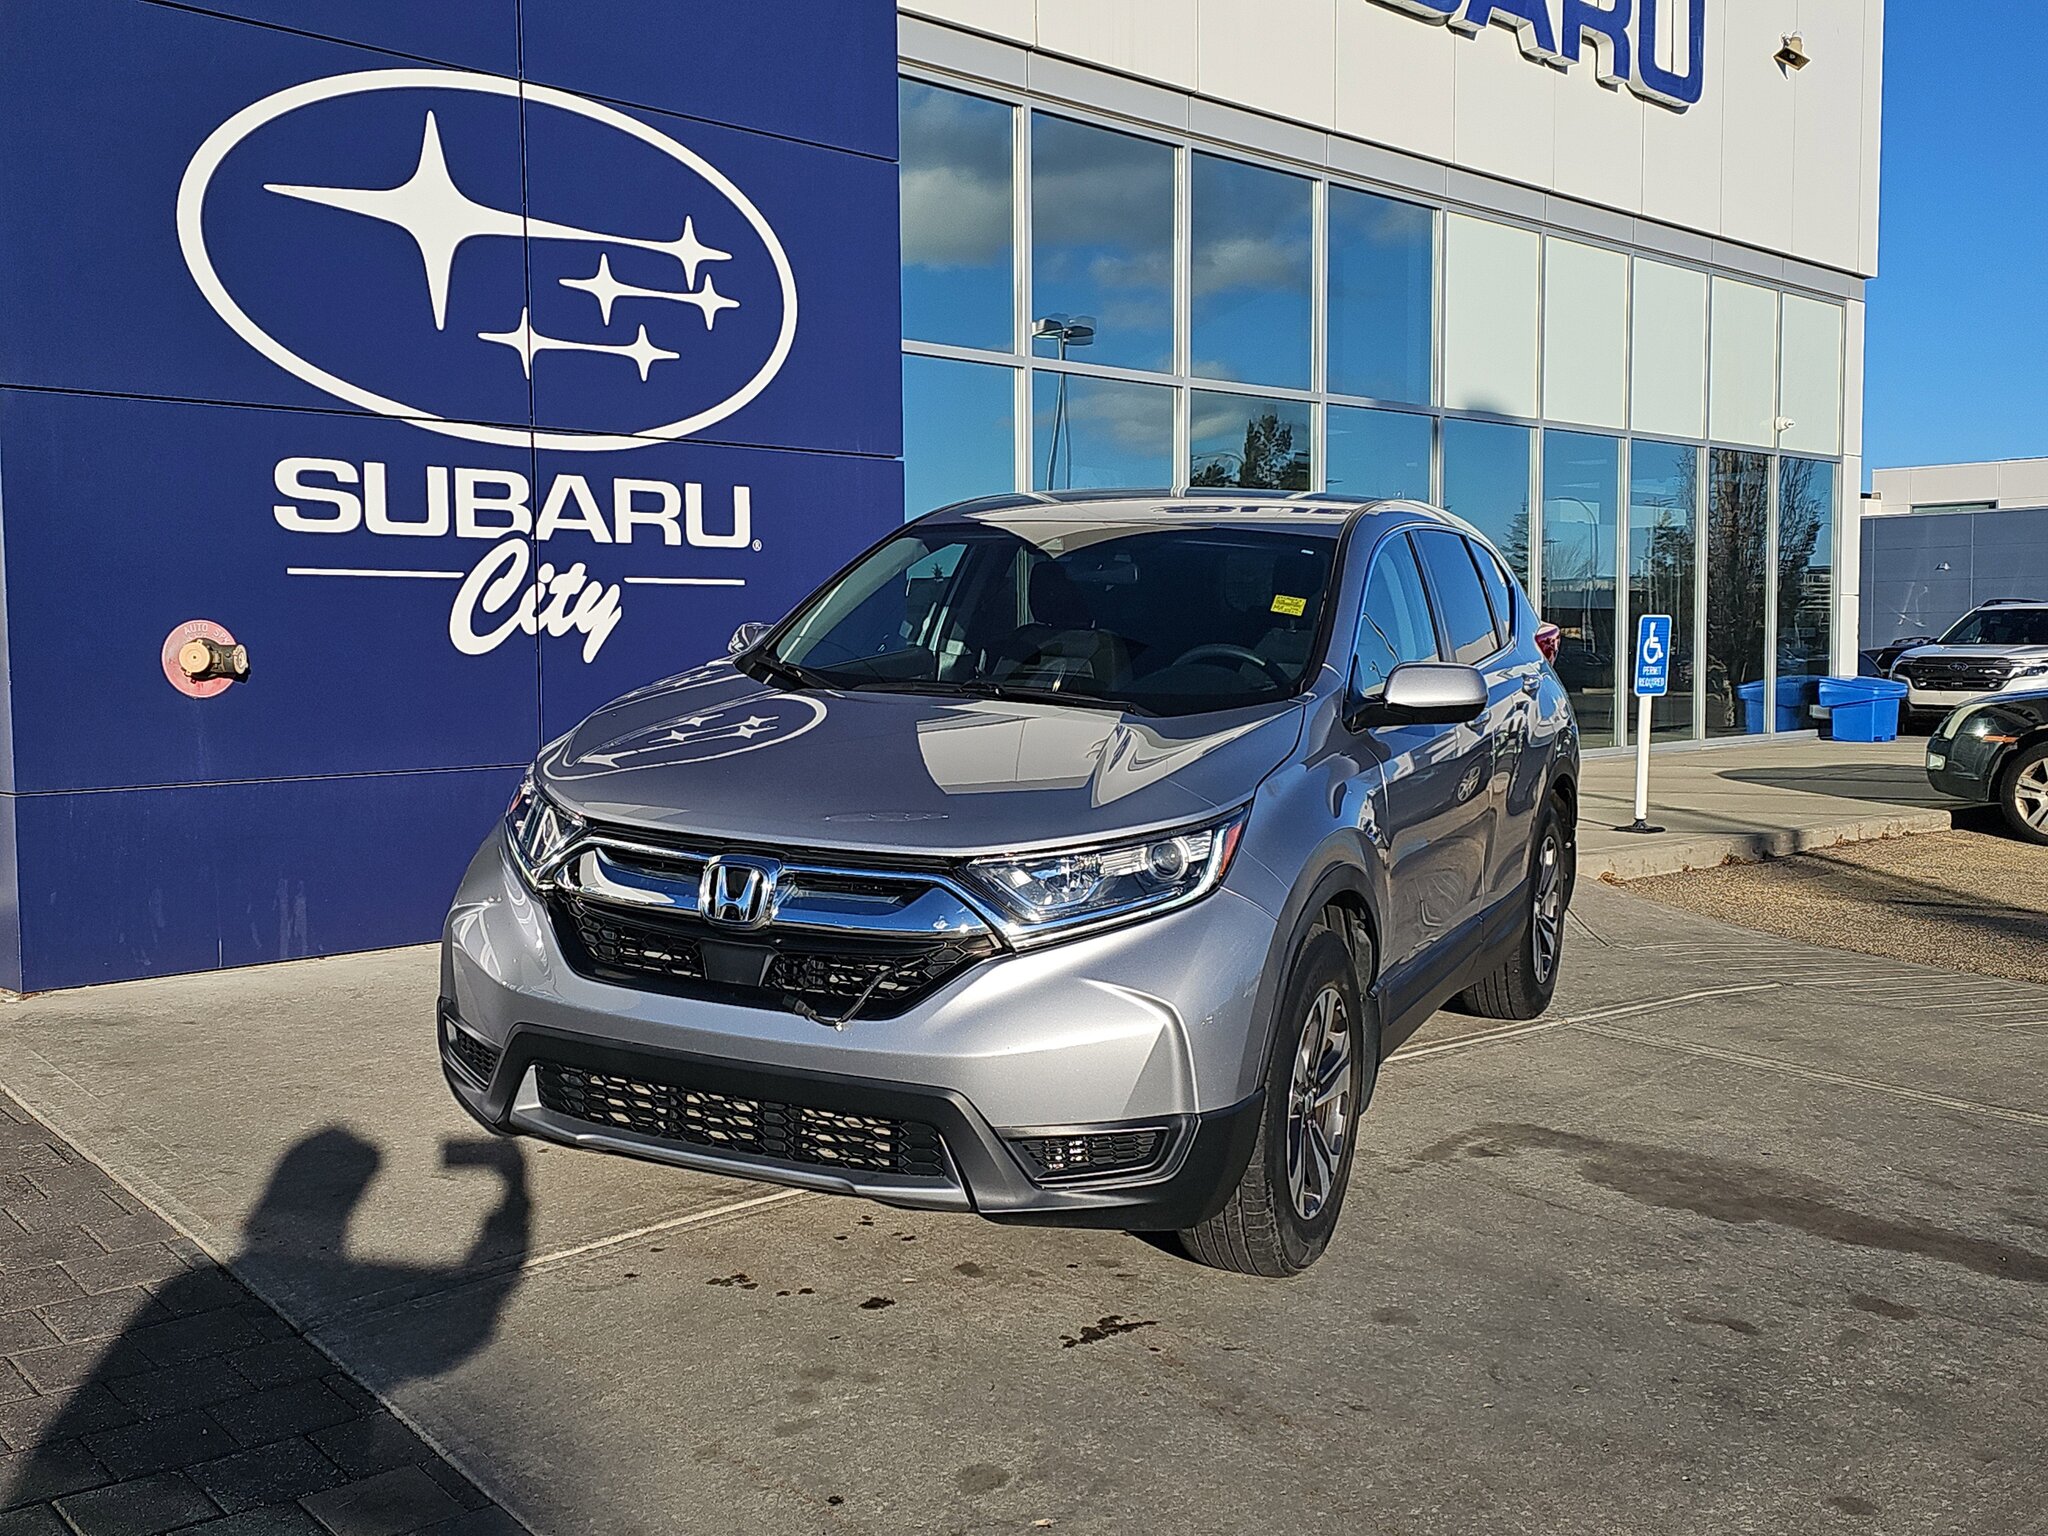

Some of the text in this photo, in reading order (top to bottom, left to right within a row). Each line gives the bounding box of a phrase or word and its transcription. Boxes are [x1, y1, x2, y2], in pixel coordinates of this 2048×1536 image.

[1366, 0, 1705, 110] RU
[449, 538, 623, 664] City
[184, 623, 208, 635] AUTO
[1642, 665, 1662, 676] PERMIT
[1638, 677, 1664, 689] REQUIRED
